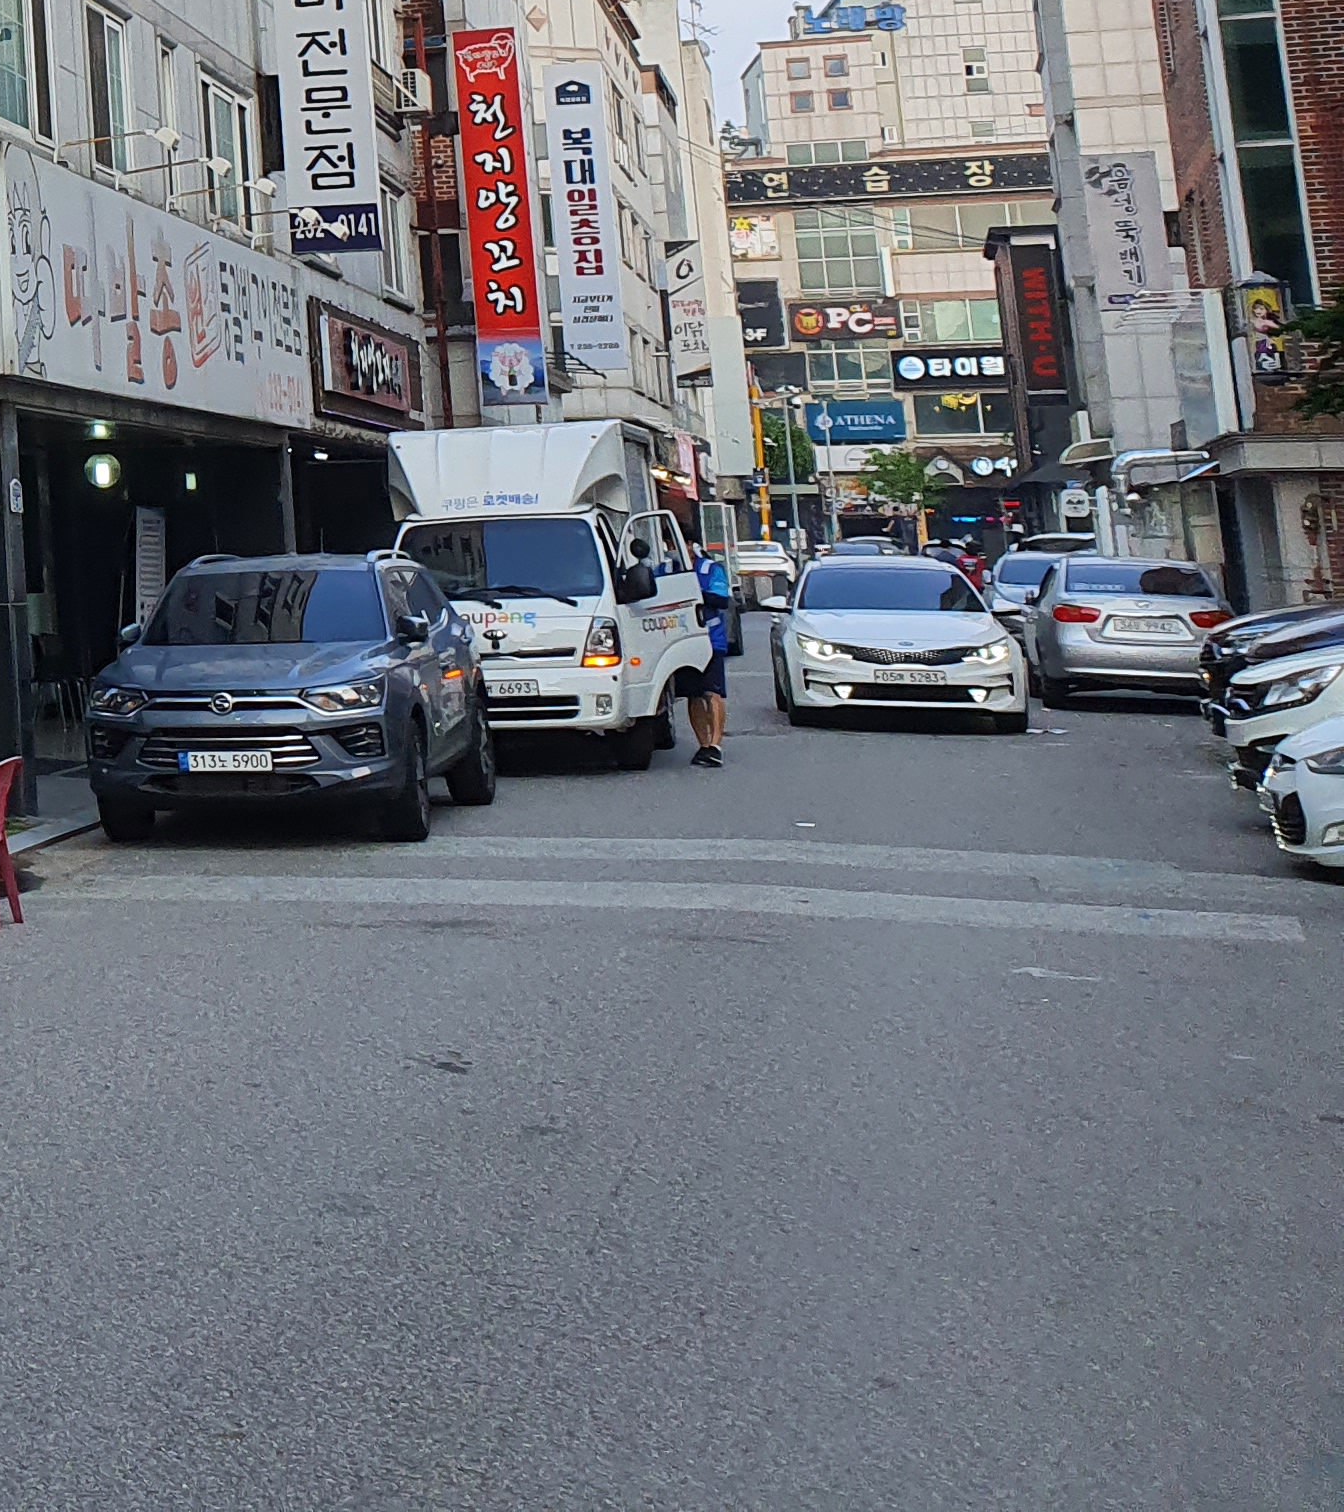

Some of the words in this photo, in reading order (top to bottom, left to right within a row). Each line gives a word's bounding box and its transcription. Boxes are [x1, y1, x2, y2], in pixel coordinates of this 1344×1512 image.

[295, 28, 356, 190] 전문점
[467, 92, 526, 316] 천지양꼬치
[835, 414, 897, 427] ATHENA
[190, 754, 229, 769] 313노
[232, 754, 269, 769] 5900
